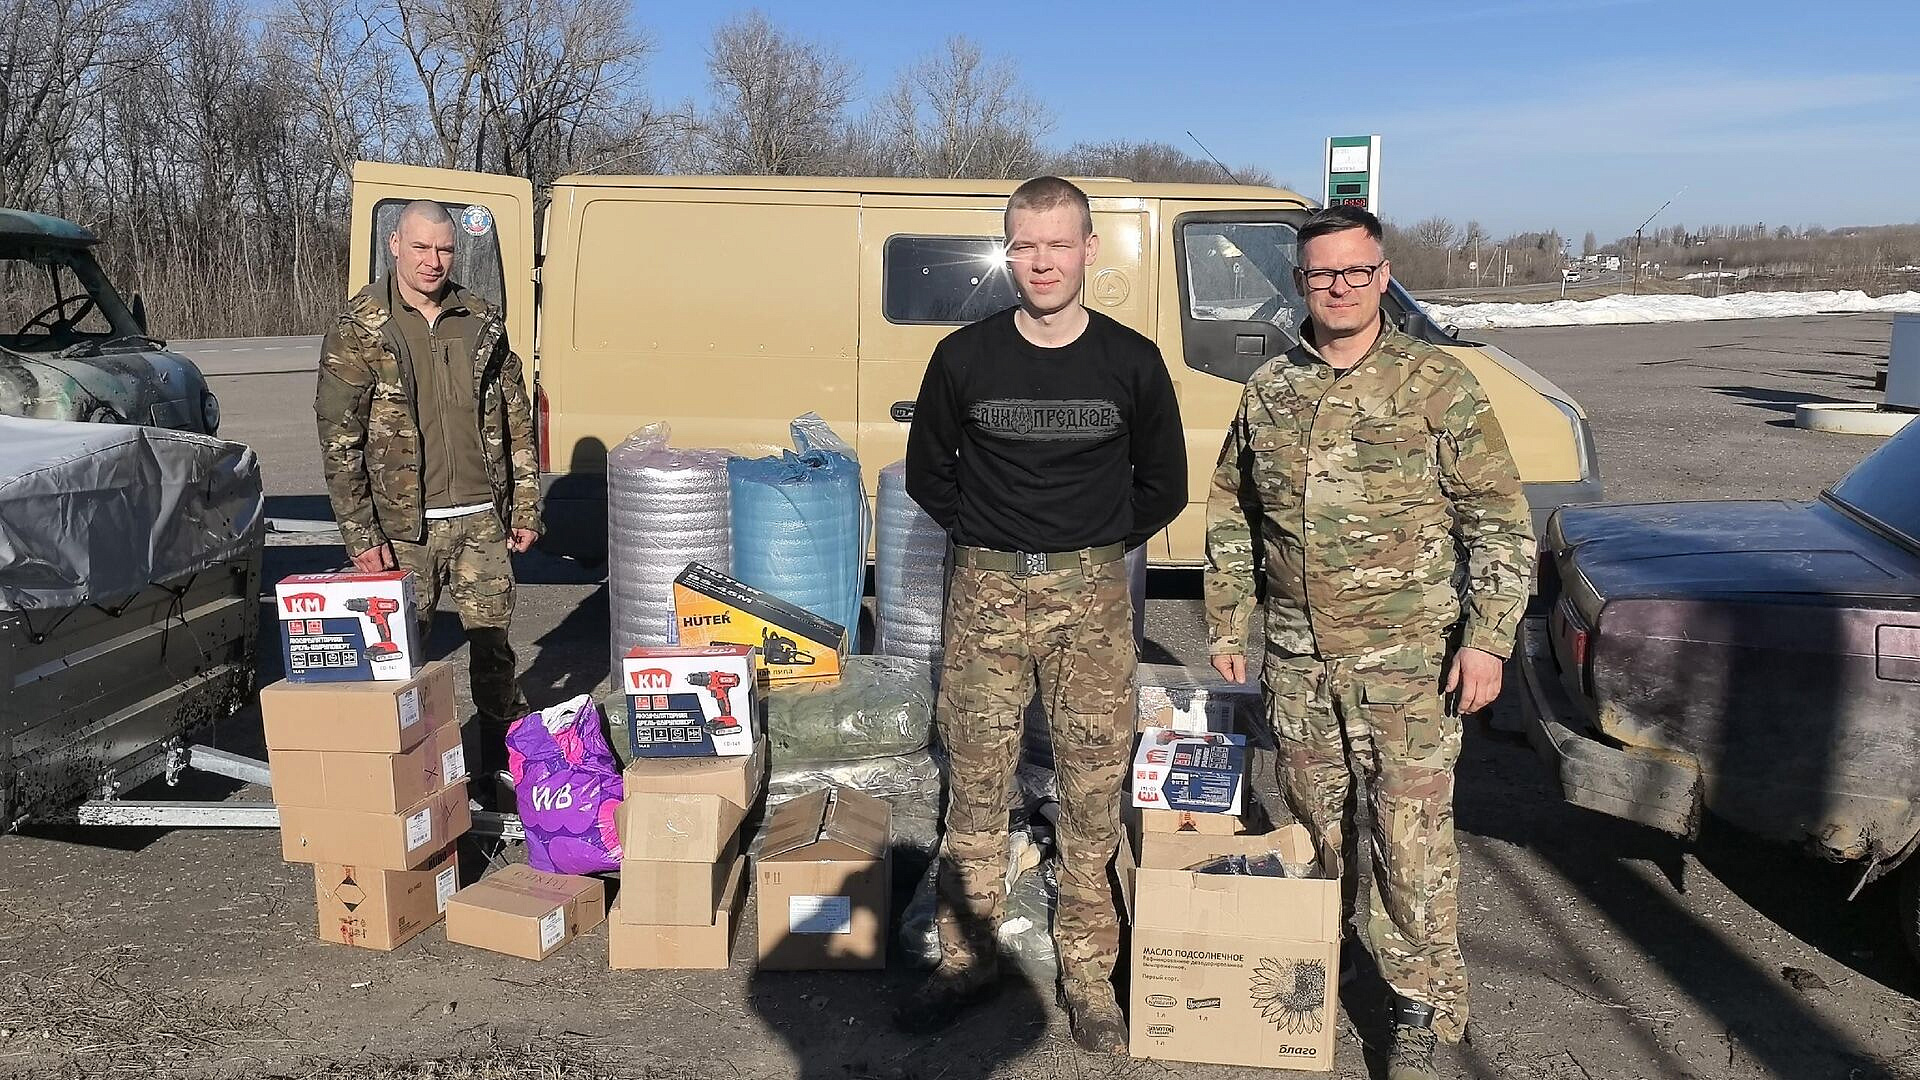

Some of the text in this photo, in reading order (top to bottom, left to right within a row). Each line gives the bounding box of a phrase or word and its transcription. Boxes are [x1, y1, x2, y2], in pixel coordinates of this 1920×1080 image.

[980, 408, 1113, 428] ДУХ ПРЕДКОВ
[531, 783, 573, 812] WB
[1142, 947, 1245, 962] МАСЛО ПОДСОЛНЕЧНОЕ
